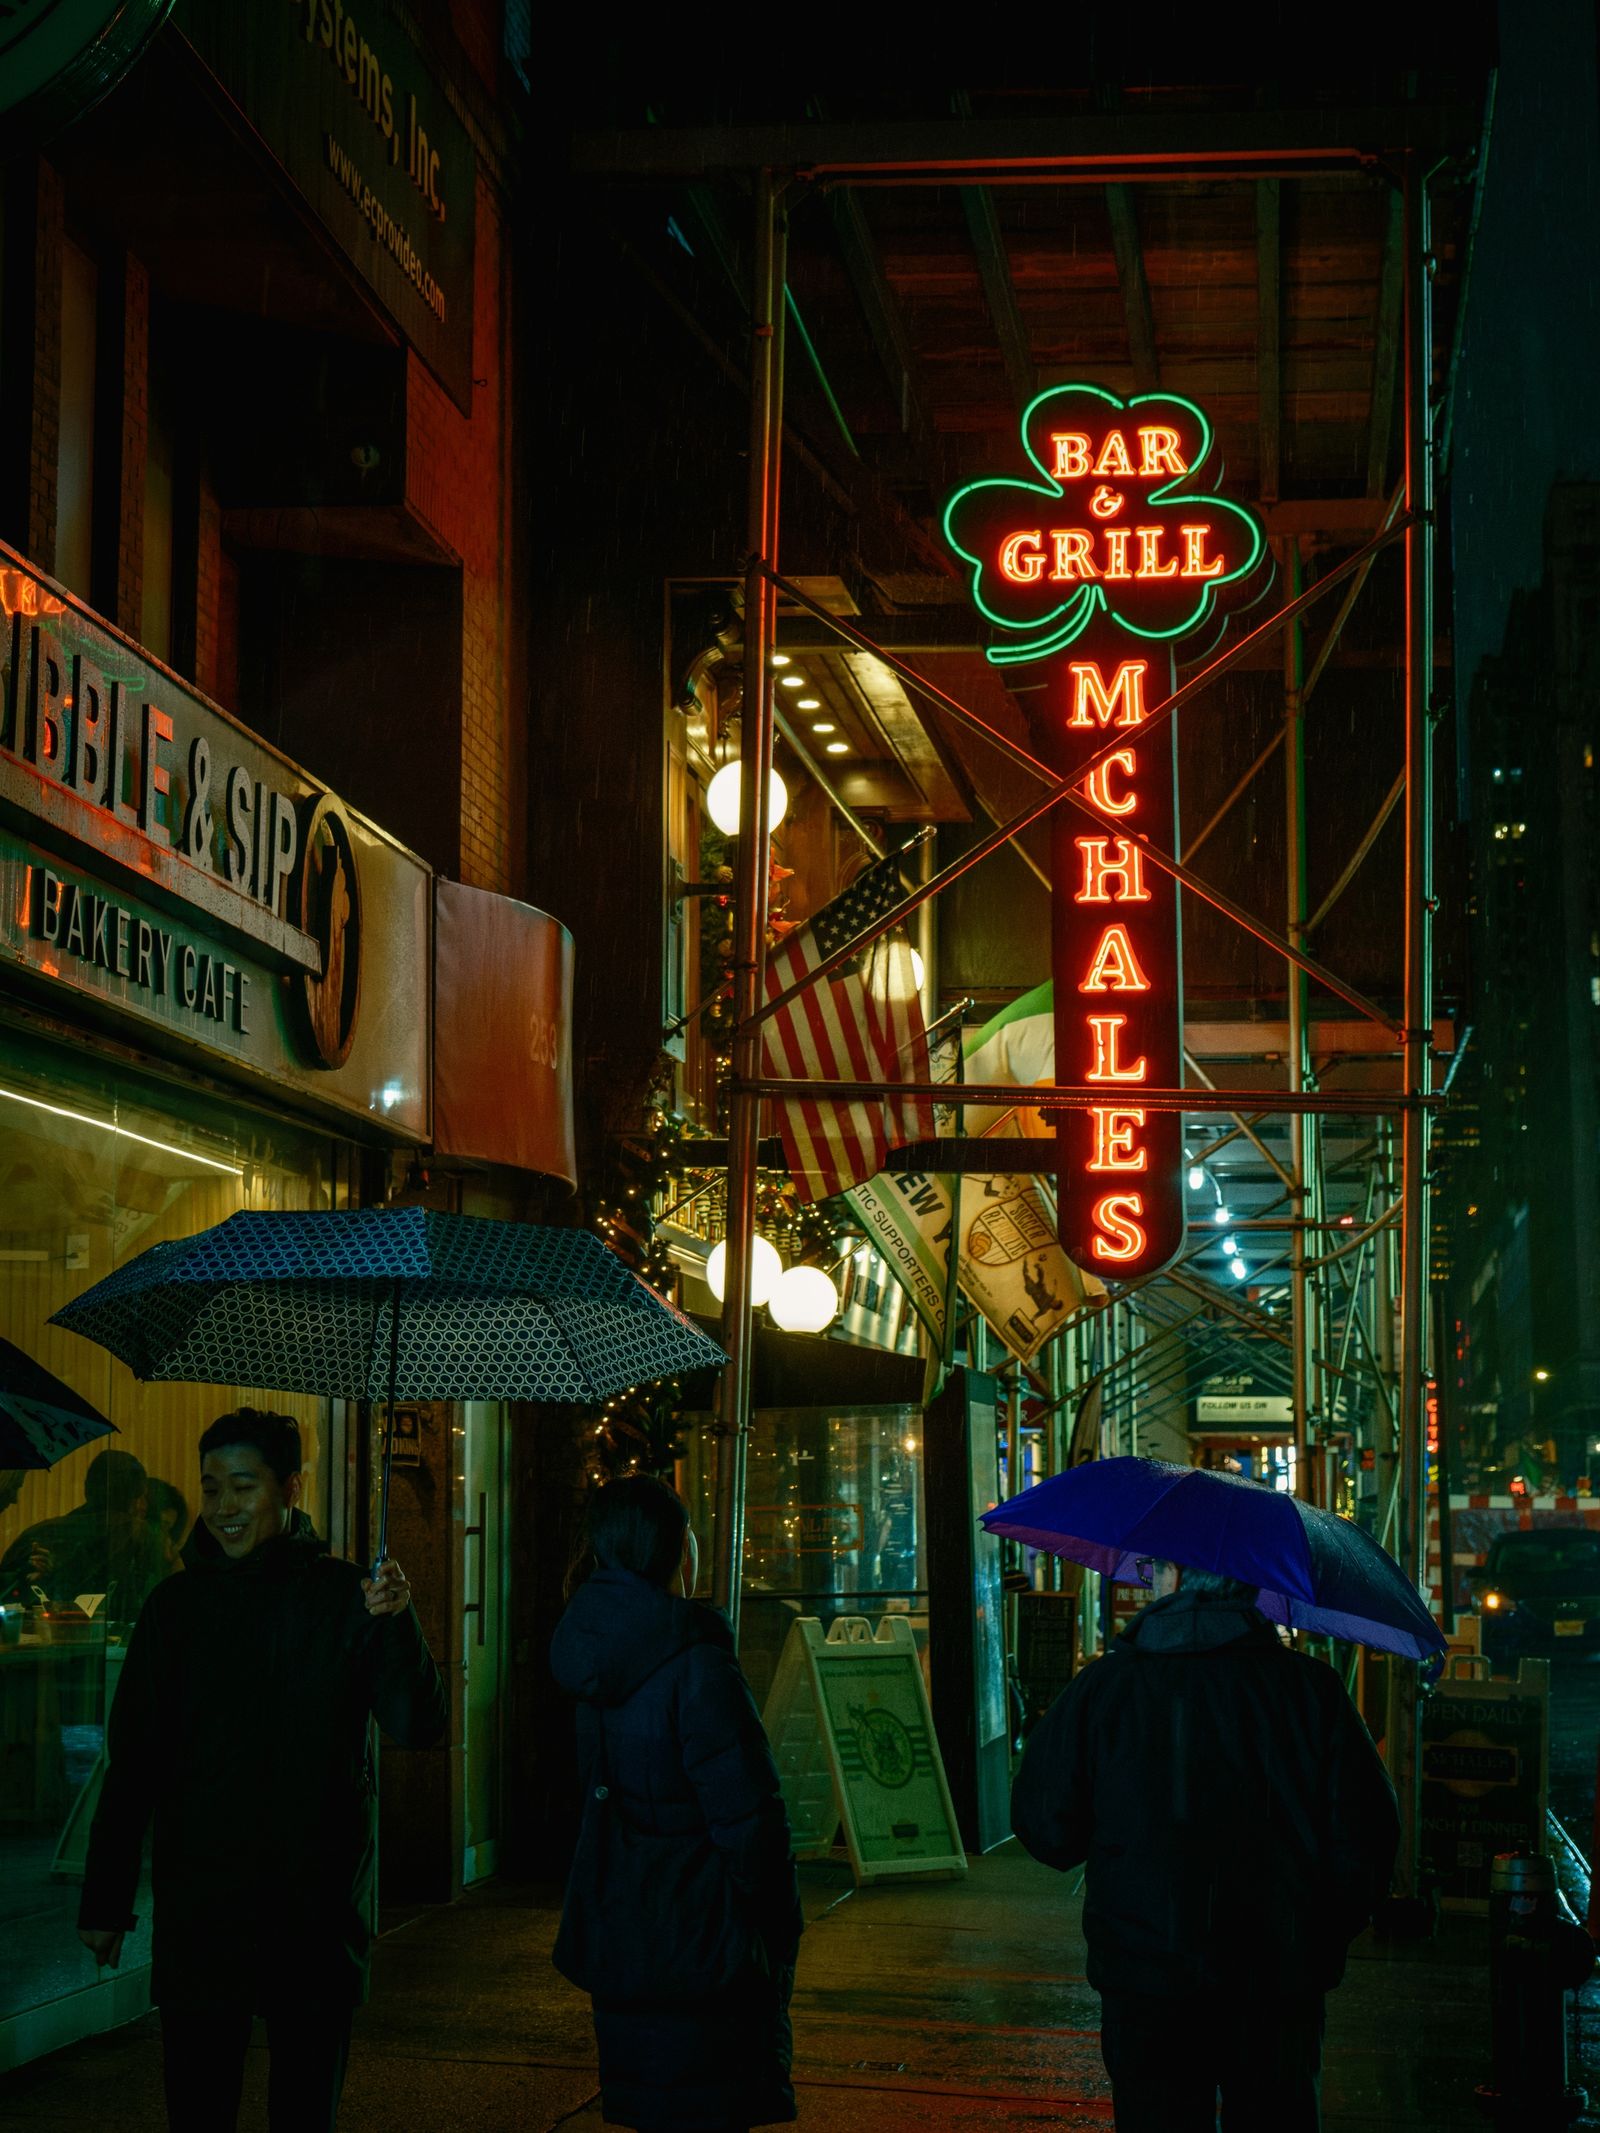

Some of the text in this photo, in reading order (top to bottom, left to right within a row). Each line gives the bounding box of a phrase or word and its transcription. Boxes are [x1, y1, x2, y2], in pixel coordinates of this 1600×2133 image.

[328, 133, 446, 323] www.ecprovideo.com
[1050, 426, 1188, 478] BAR
[1089, 484, 1124, 518] &
[999, 524, 1225, 582] GRILL
[0, 612, 297, 917] IBBLE & SIP
[42, 868, 251, 1034] BAKERY CAFE
[888, 1171, 945, 1217] EW
[1009, 1203, 1047, 1240] SOCCER
[873, 1210, 939, 1308] SUPPORTERS
[1472, 1704, 1528, 1725] DAILY
